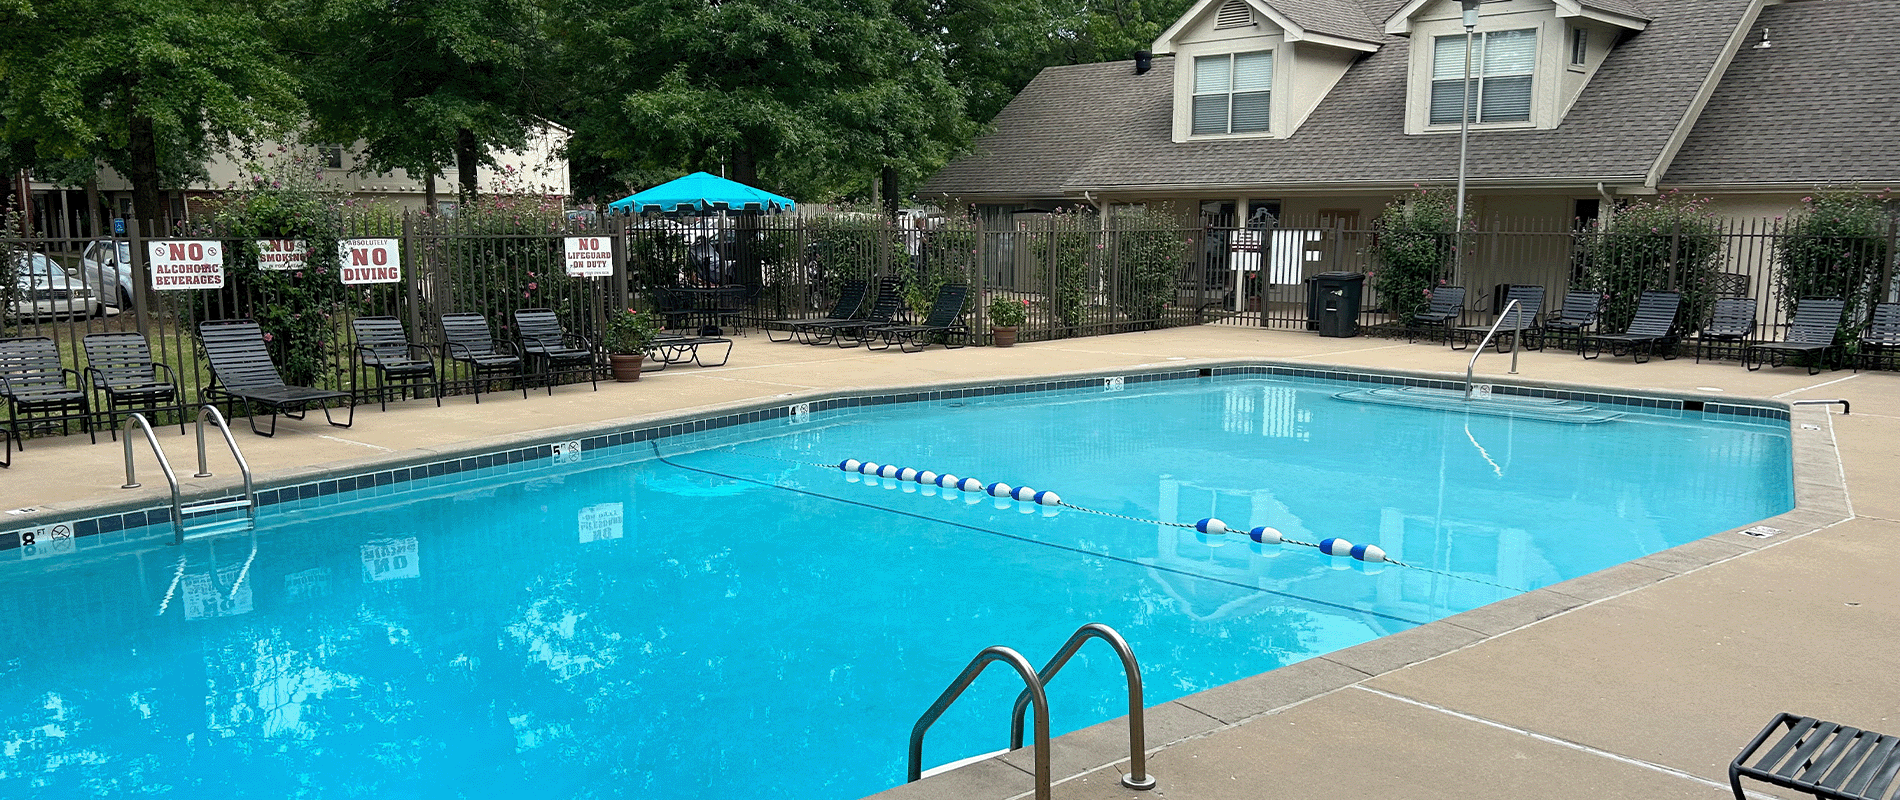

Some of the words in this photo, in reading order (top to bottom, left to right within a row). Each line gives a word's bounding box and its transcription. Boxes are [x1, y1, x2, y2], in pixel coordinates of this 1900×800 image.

[270, 240, 295, 252] NO
[578, 238, 600, 250] NO
[169, 243, 204, 261] NO
[352, 247, 388, 266] NO
[567, 252, 611, 260] LIFEGUARD
[586, 260, 607, 268] DUTY
[343, 266, 398, 281] DIVING
[156, 274, 222, 286] BEVERAGES
[37, 528, 46, 536] FT
